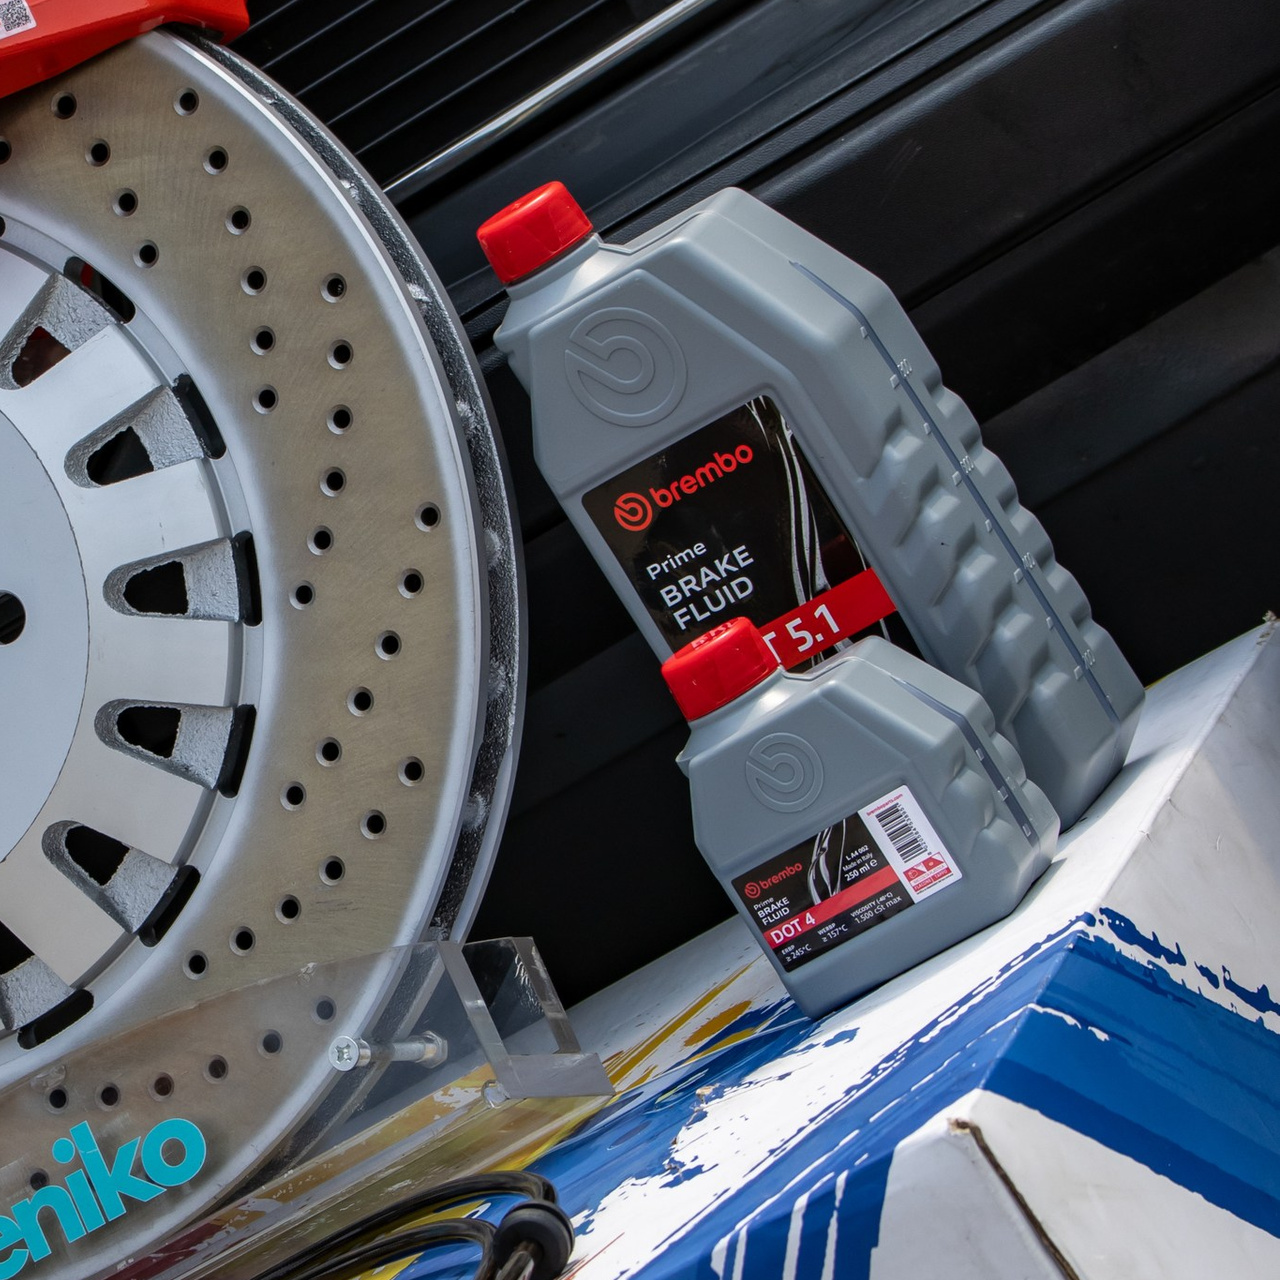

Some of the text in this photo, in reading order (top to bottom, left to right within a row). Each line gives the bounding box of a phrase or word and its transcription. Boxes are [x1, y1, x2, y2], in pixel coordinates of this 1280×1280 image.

[649, 444, 753, 508] brembo
[646, 542, 707, 580] Prime
[660, 545, 754, 607] BRAKE
[673, 576, 754, 631] FLUID
[785, 603, 840, 652] 5.1
[842, 861, 857, 872] Made
[861, 852, 873, 861] Italy
[844, 869, 860, 882] 250
[859, 863, 870, 874] ml
[759, 862, 803, 889] brembo
[753, 896, 774, 911] Prime
[758, 897, 790, 919] BRAKE
[850, 899, 878, 917] VISCOSITY
[854, 895, 902, 924] 1.500 cSt max
[762, 907, 790, 926] FLUID
[770, 913, 816, 944] DOT 4
[818, 922, 836, 935] WERBP
[781, 945, 795, 955] ERBP
